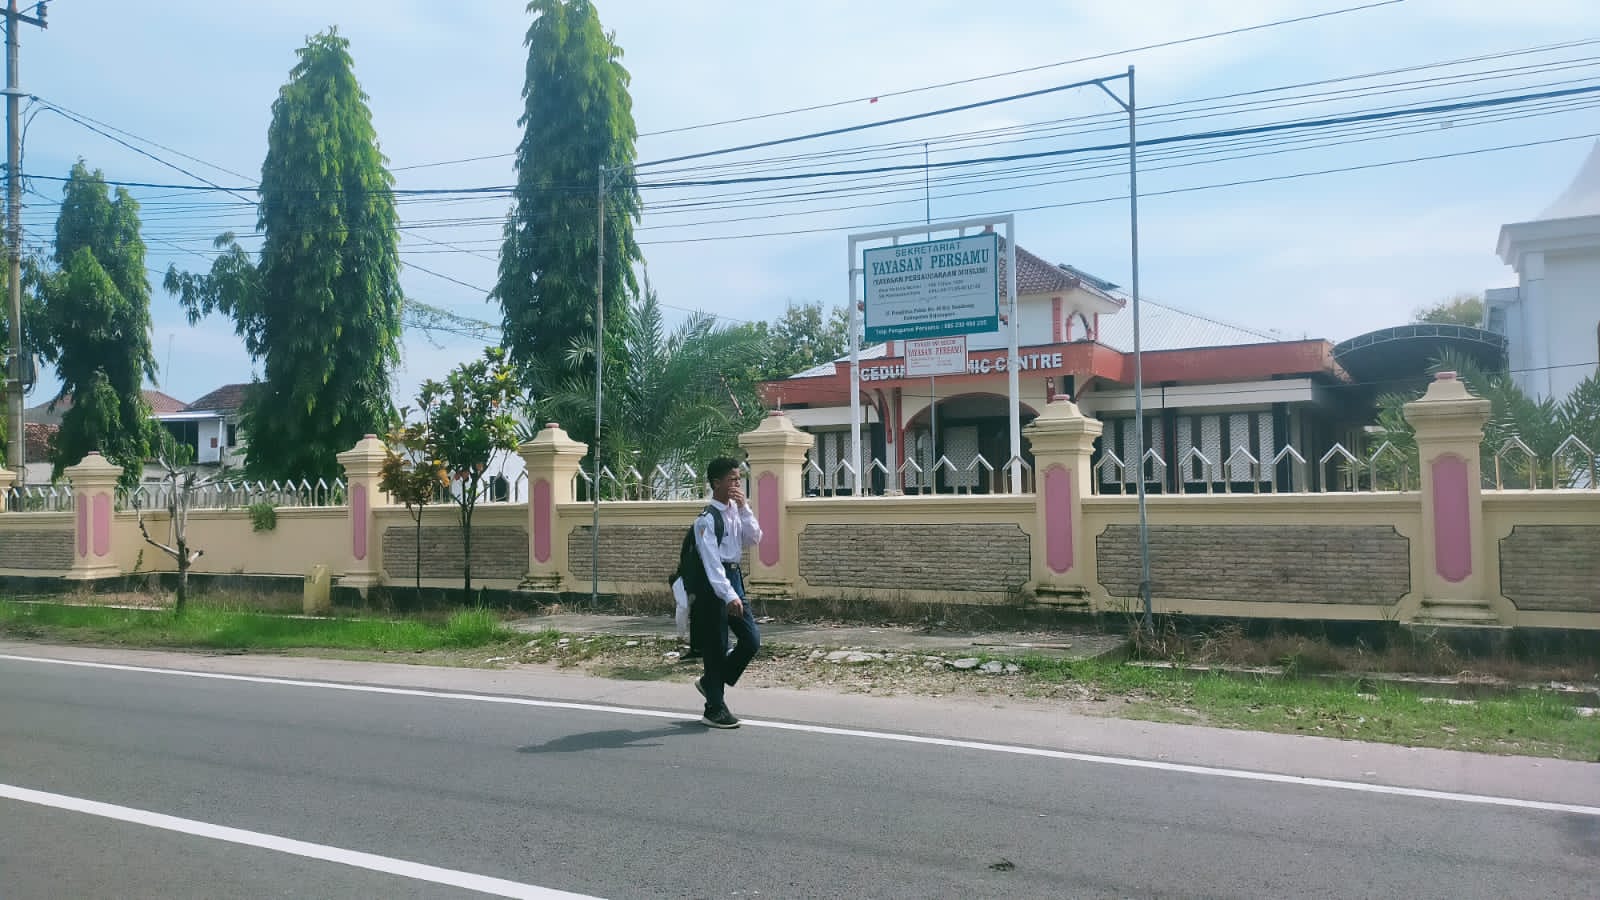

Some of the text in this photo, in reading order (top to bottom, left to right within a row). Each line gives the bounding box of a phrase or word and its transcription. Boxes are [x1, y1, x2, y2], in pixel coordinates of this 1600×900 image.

[895, 241, 960, 258] SEKRETARIAT
[872, 248, 989, 276] YAYASAN PERSAMU
[908, 347, 932, 358] YAYASAN
[994, 352, 1063, 372] CNTRE
